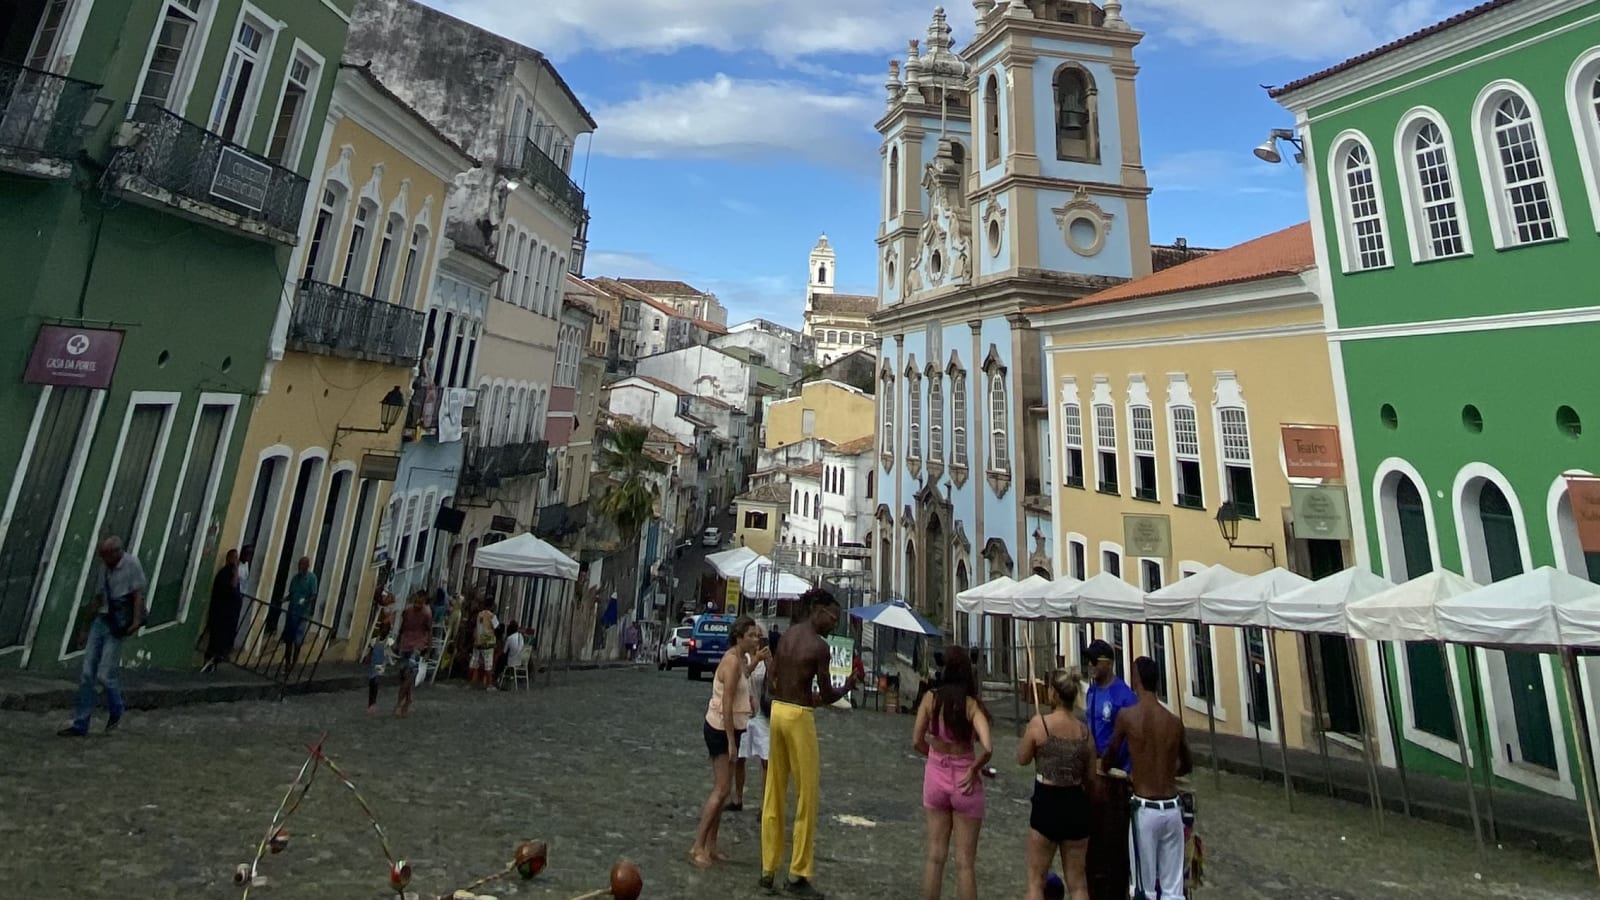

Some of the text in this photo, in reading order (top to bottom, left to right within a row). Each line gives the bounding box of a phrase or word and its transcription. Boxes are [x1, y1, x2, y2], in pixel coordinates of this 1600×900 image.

[46, 358, 64, 369] CASA
[64, 359, 75, 370] DA
[1292, 438, 1328, 455] Teatro
